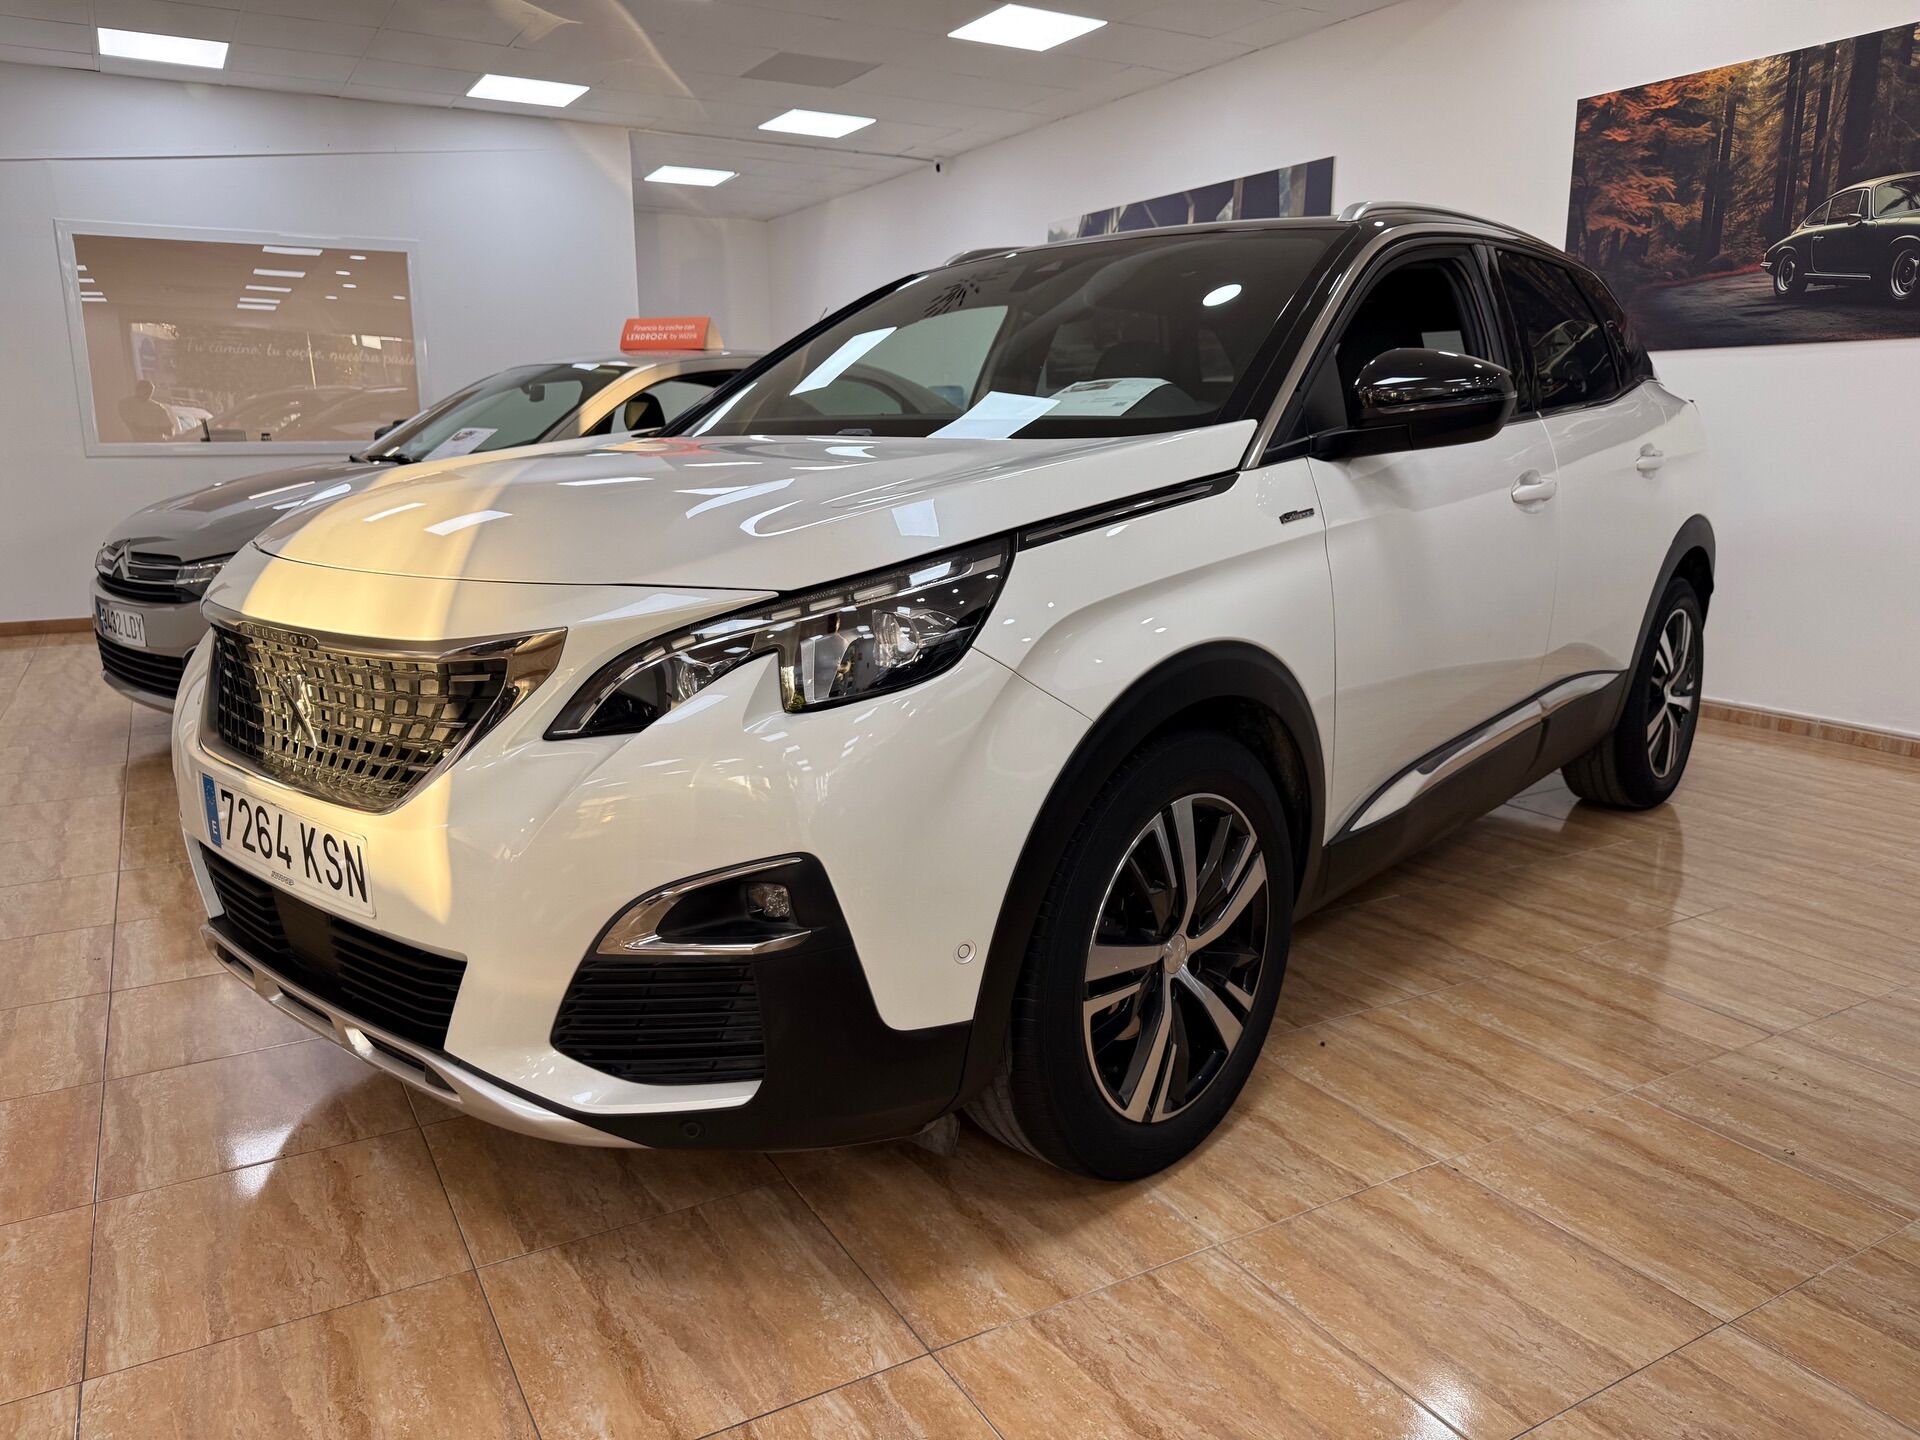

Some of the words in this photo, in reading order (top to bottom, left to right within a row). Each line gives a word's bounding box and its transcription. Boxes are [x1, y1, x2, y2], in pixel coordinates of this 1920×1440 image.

[626, 332, 668, 341] LENDROCK
[266, 342, 281, 357] tu
[123, 614, 143, 640] LDY
[247, 624, 308, 647] PEUGEOT
[211, 820, 218, 835] E
[221, 788, 292, 870] 7264
[300, 822, 368, 904] KSN
